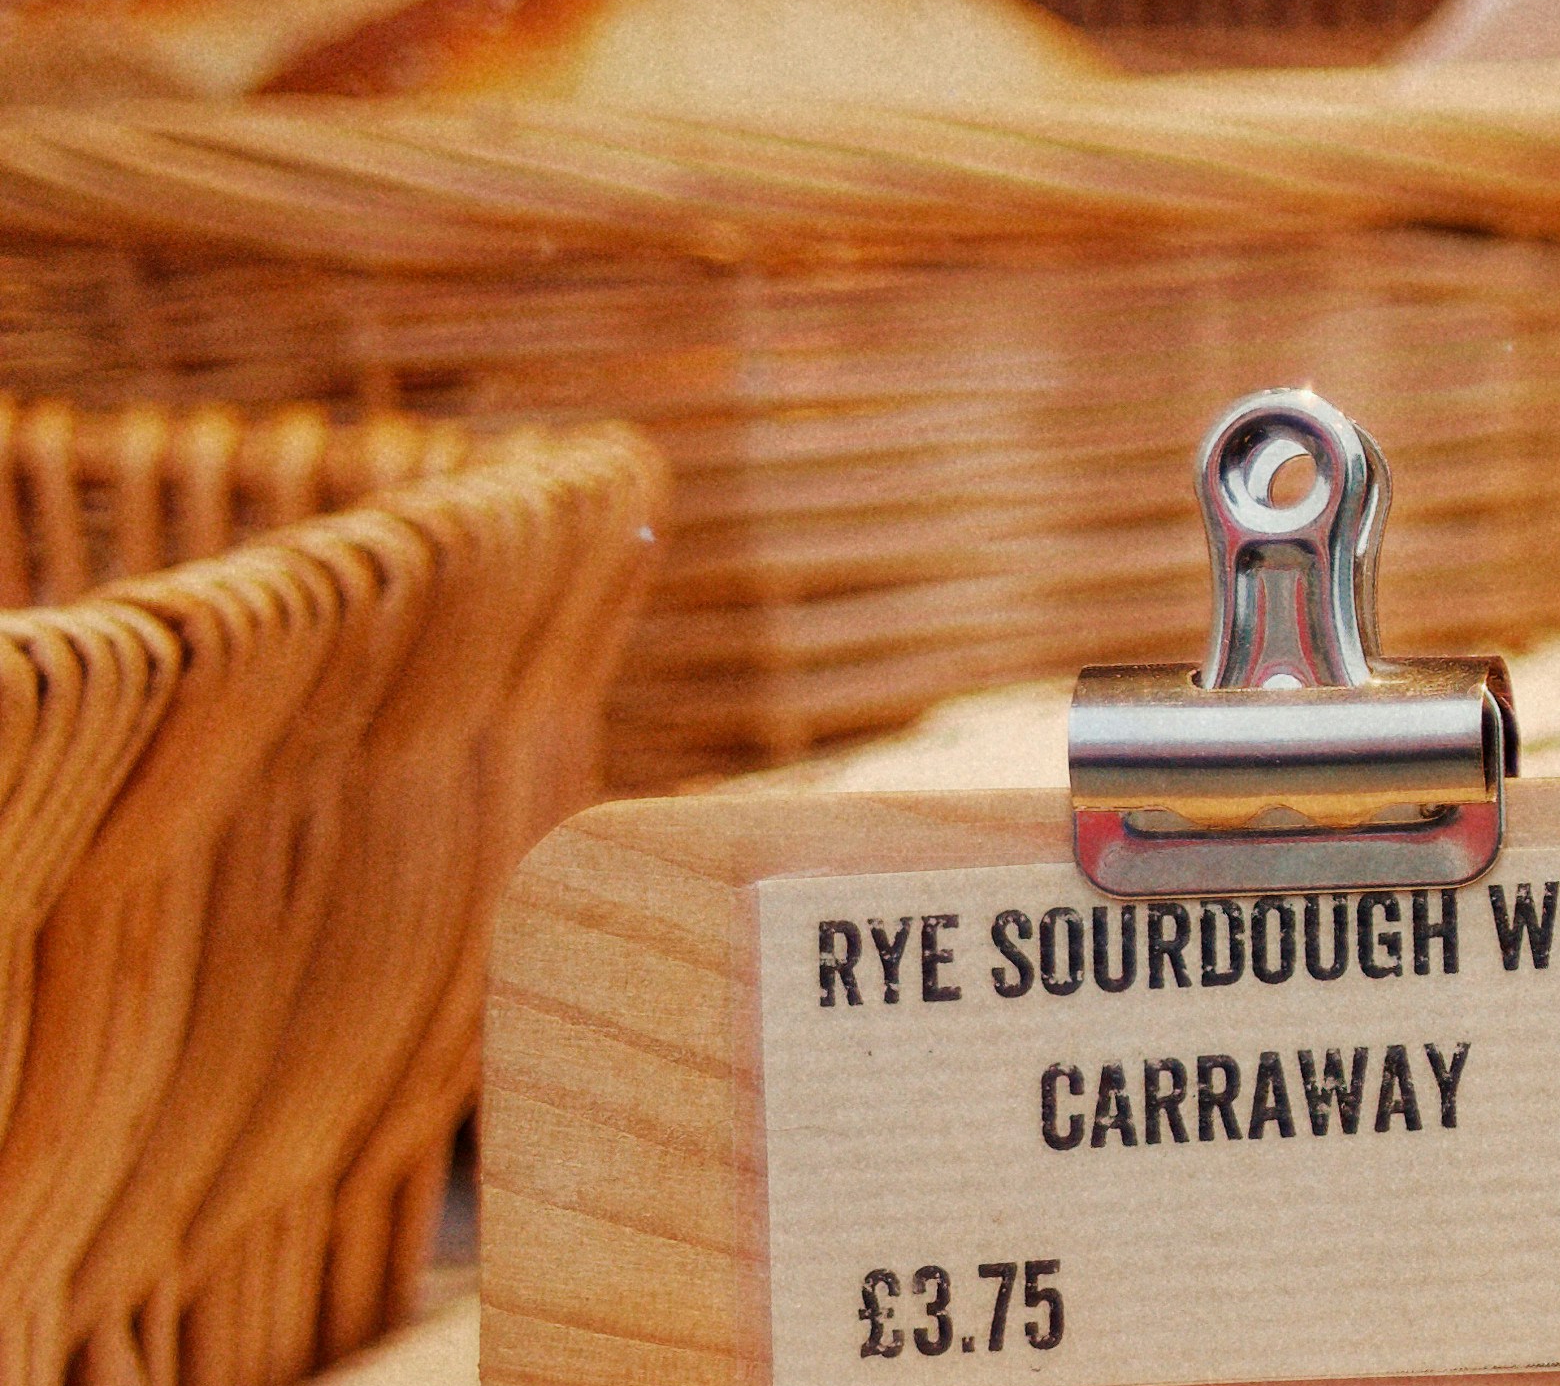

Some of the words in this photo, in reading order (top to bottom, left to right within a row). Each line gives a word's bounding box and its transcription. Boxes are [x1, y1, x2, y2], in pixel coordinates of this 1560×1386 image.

[818, 914, 962, 1008] RYE
[990, 889, 1459, 999] SOURDOUGH
[1040, 1041, 1472, 1152] CARRAWAY
[857, 1258, 1064, 1359] £3.75
